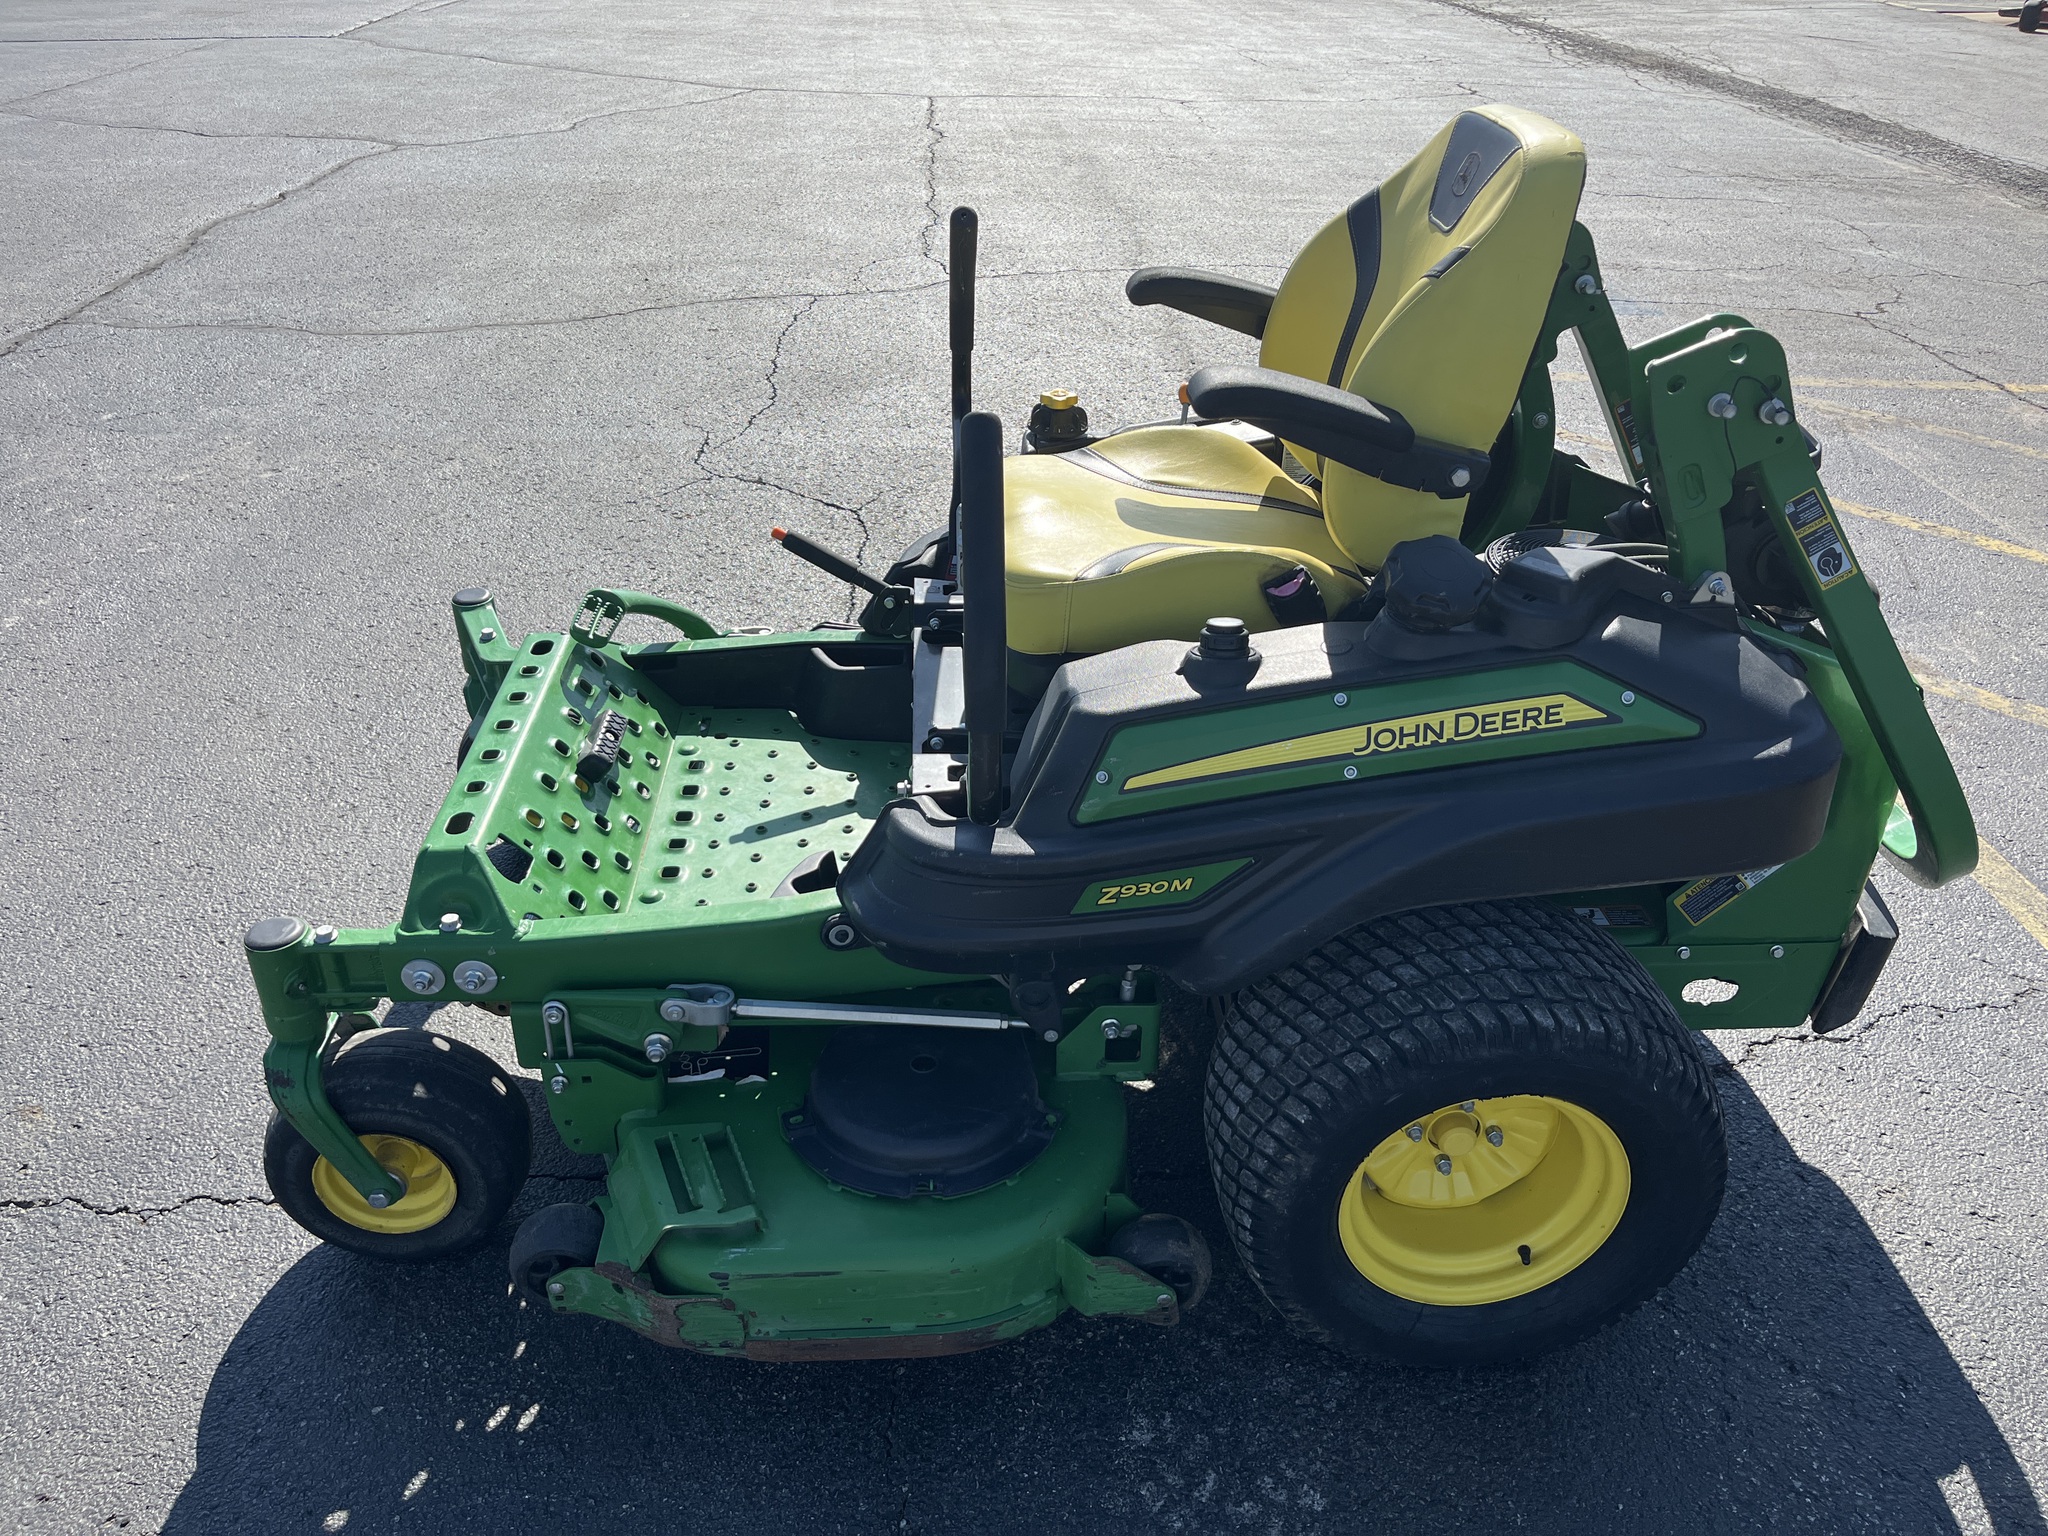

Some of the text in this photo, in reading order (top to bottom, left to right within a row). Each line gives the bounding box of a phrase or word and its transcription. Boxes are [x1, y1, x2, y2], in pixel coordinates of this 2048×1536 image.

[1824, 572, 1849, 589] CAUTION
[1354, 703, 1563, 753] JOHN DEERE
[1097, 877, 1193, 905] Z930M
